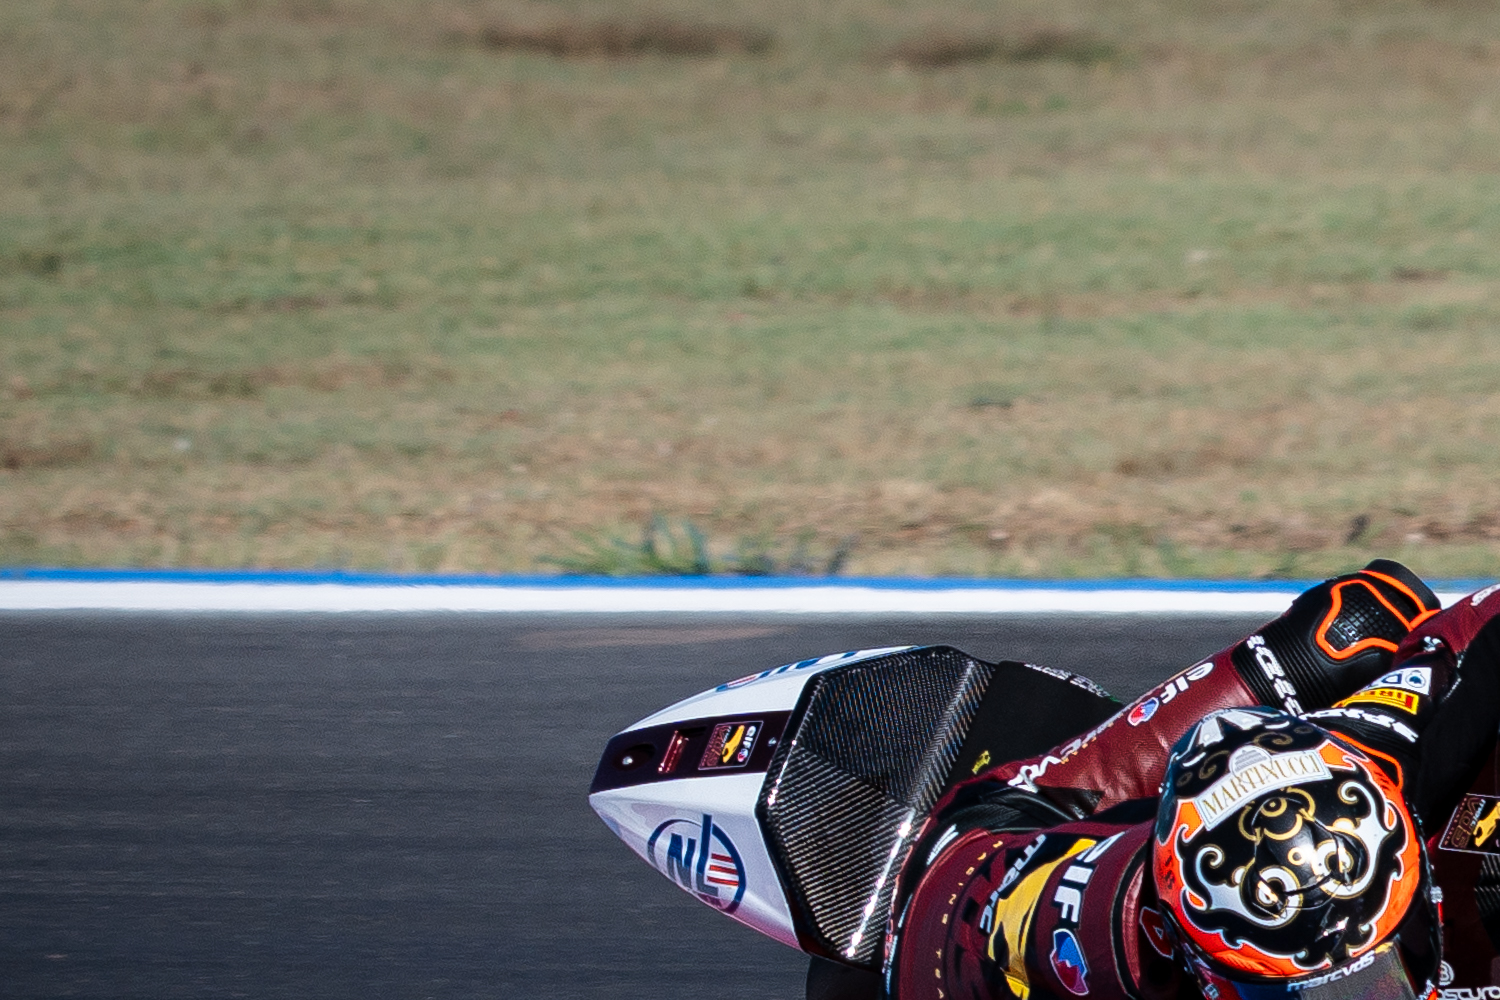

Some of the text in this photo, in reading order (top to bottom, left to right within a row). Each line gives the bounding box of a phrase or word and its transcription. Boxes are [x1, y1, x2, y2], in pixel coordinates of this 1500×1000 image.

[1160, 662, 1214, 704] elf
[1203, 754, 1320, 820] MARTINUCCI
[979, 834, 1046, 933] marc
